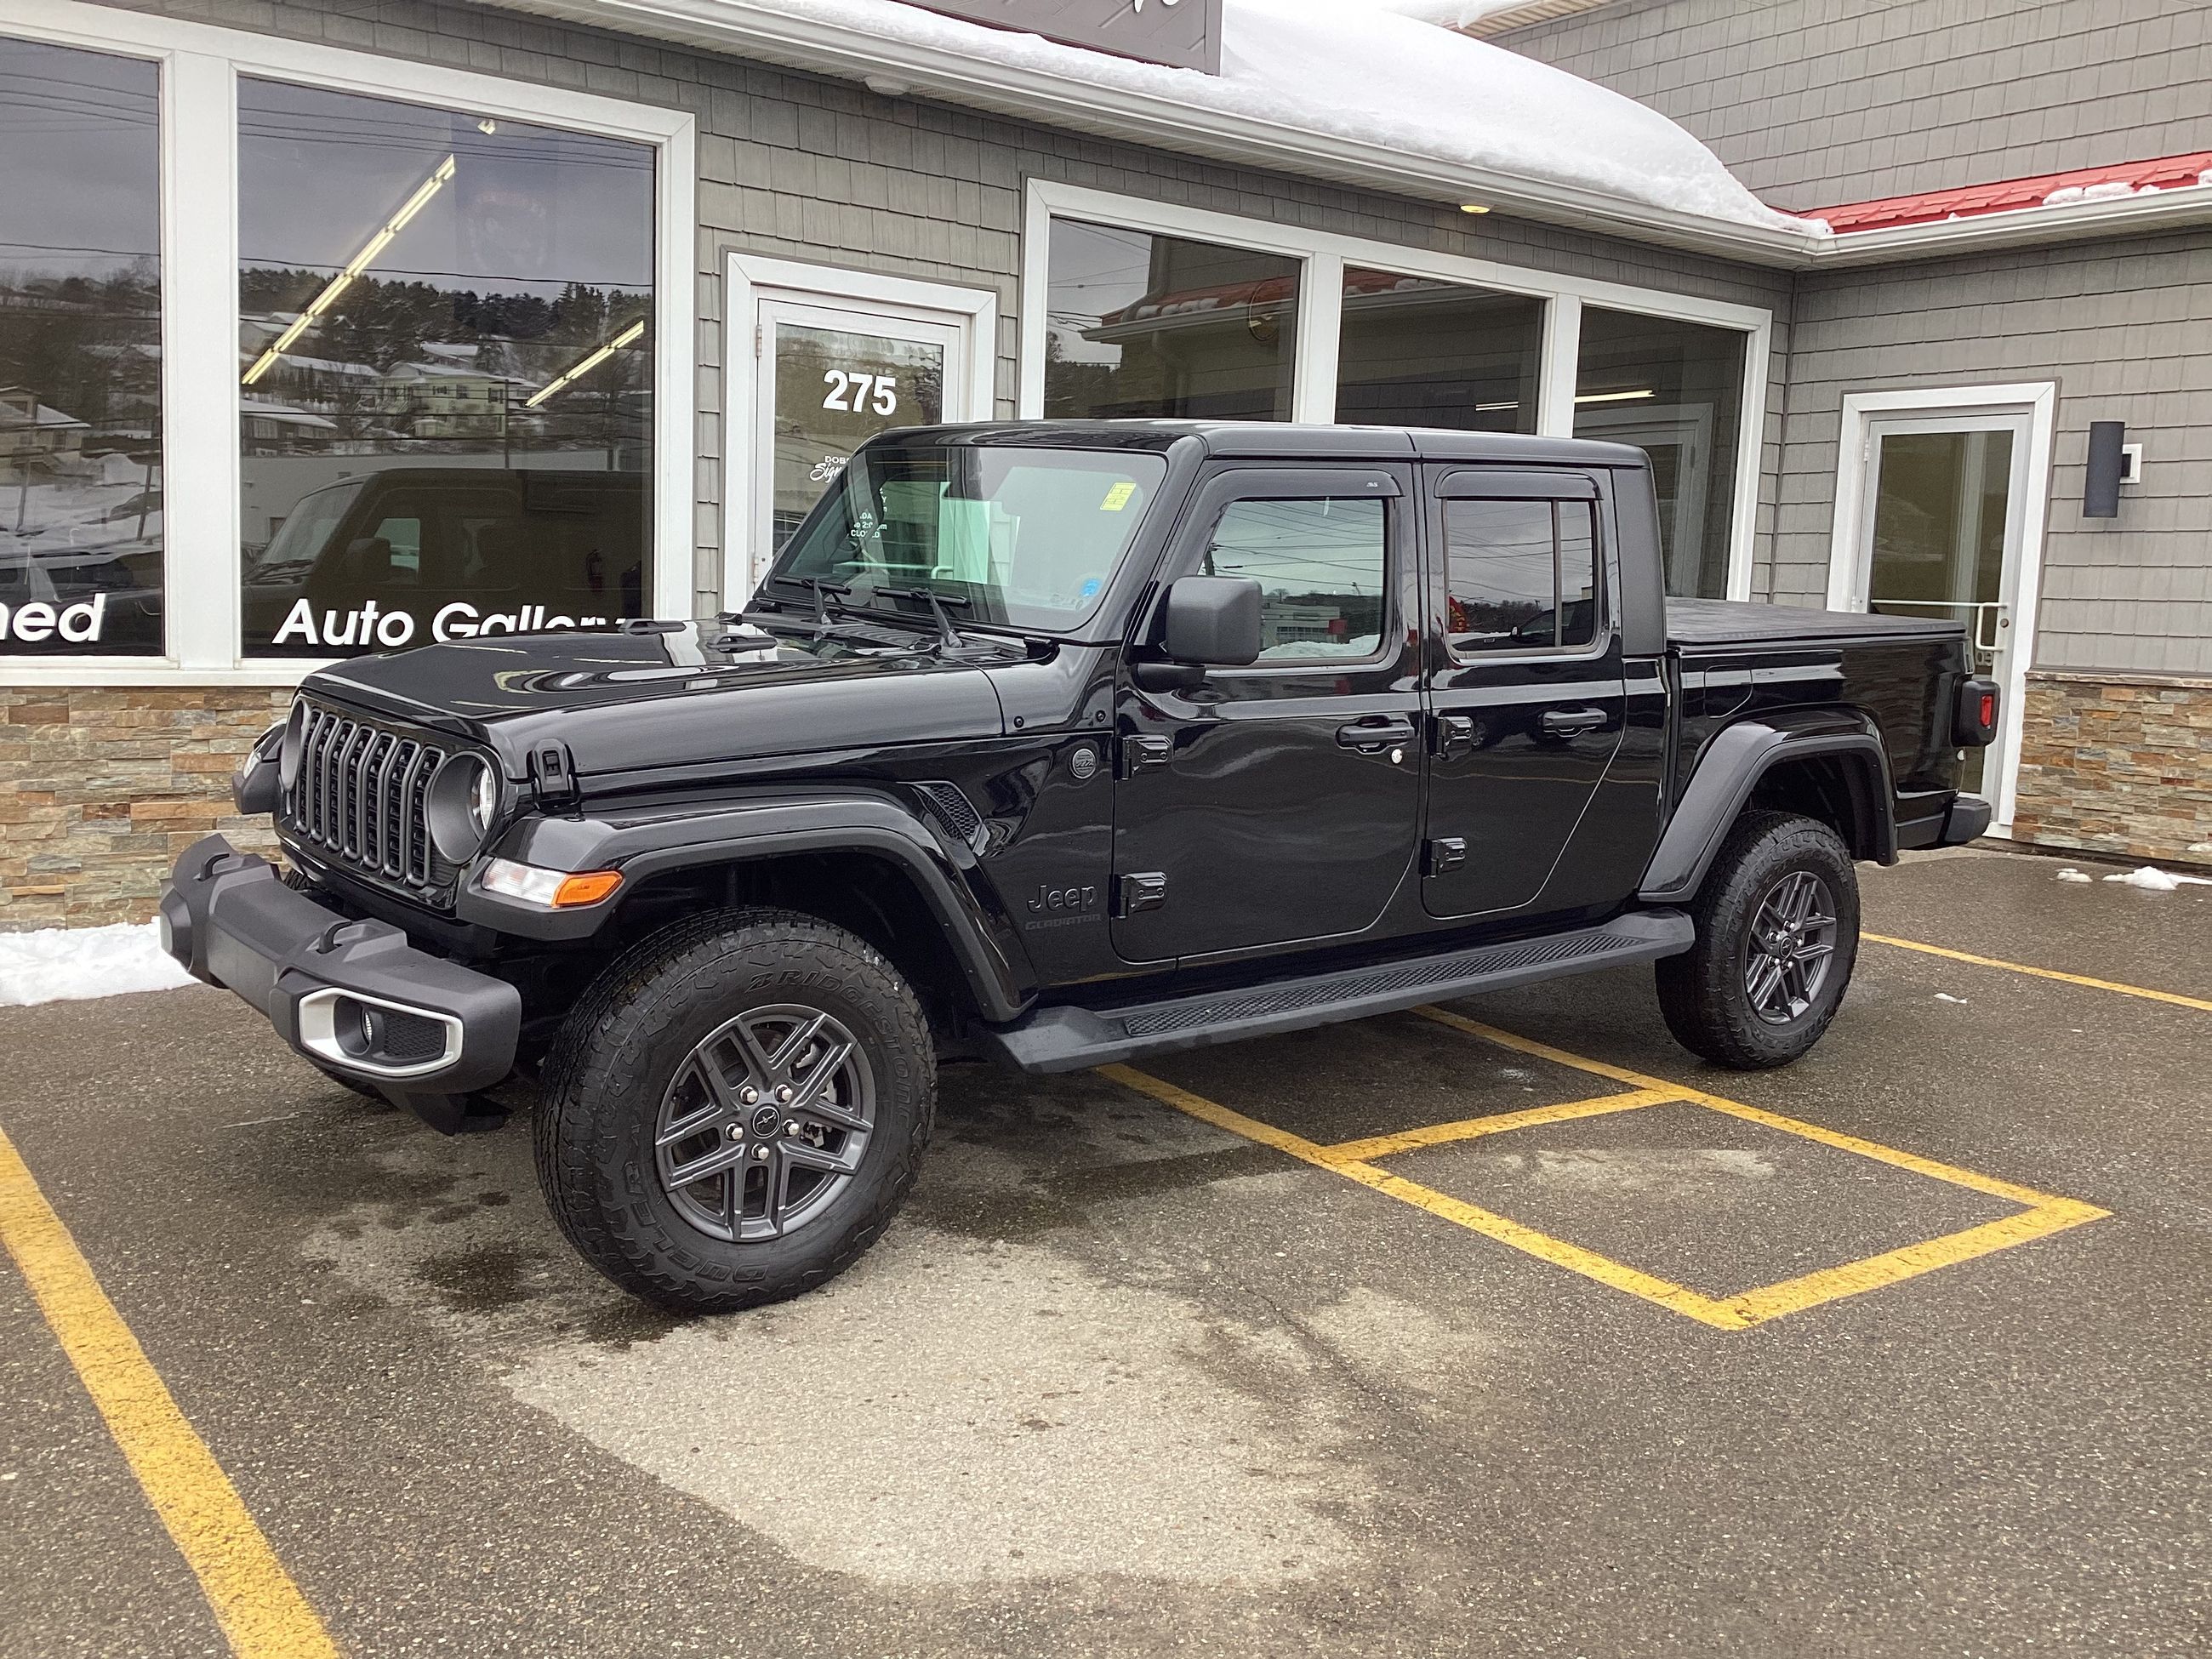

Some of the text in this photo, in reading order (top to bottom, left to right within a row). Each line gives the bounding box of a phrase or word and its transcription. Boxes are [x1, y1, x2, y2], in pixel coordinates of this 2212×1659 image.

[822, 369, 897, 416] 275
[0, 592, 106, 642] ed
[271, 598, 414, 647] Auto
[1027, 884, 1098, 913] Jeep
[744, 969, 912, 1130] BRIDGESTONE
[622, 1160, 770, 1284] DUELER
